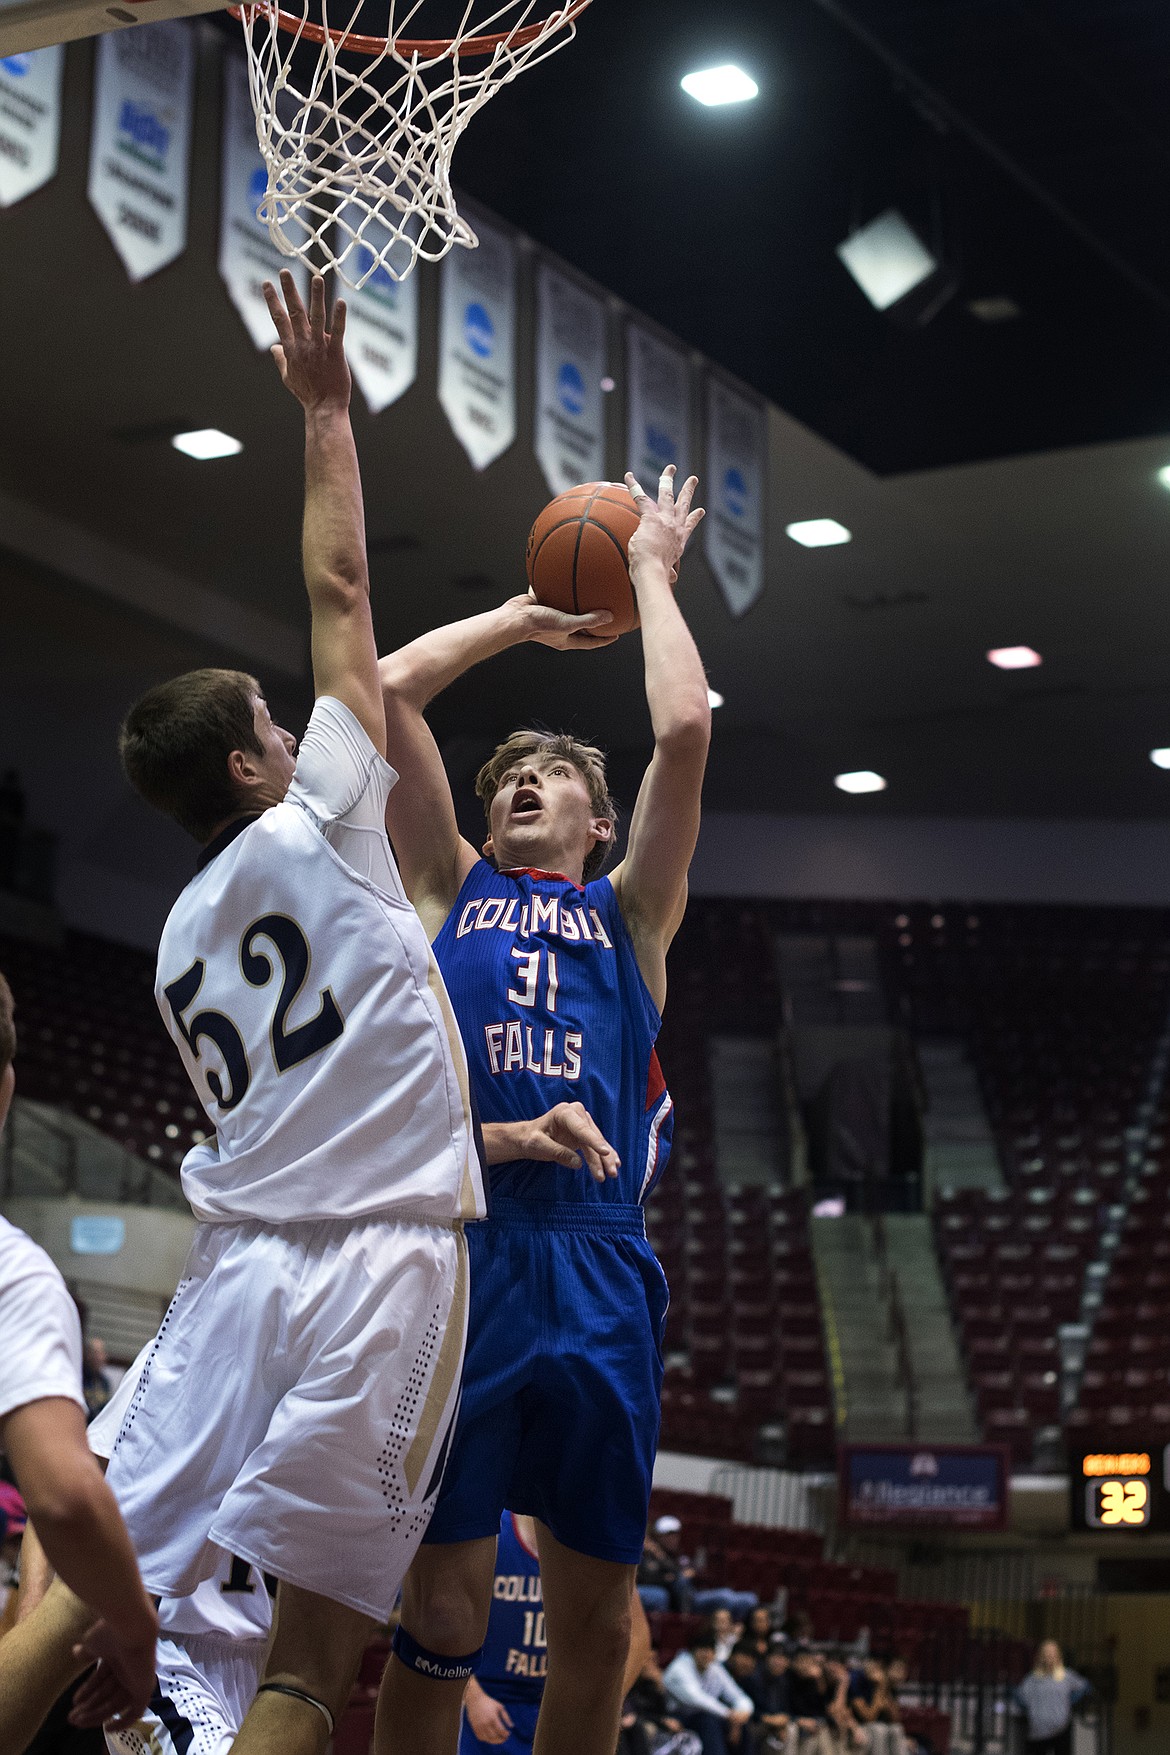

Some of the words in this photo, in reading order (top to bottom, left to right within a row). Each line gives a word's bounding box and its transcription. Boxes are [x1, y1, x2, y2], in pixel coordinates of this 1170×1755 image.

[456, 893, 613, 948] COLUMBIA
[507, 946, 559, 1012] 31
[162, 911, 346, 1112] 52
[484, 1021, 583, 1080] FALLS
[1100, 1481, 1147, 1525] 32
[493, 1575, 543, 1603] COLU
[424, 1660, 473, 1679] Mueller
[505, 1648, 548, 1677] FALL
